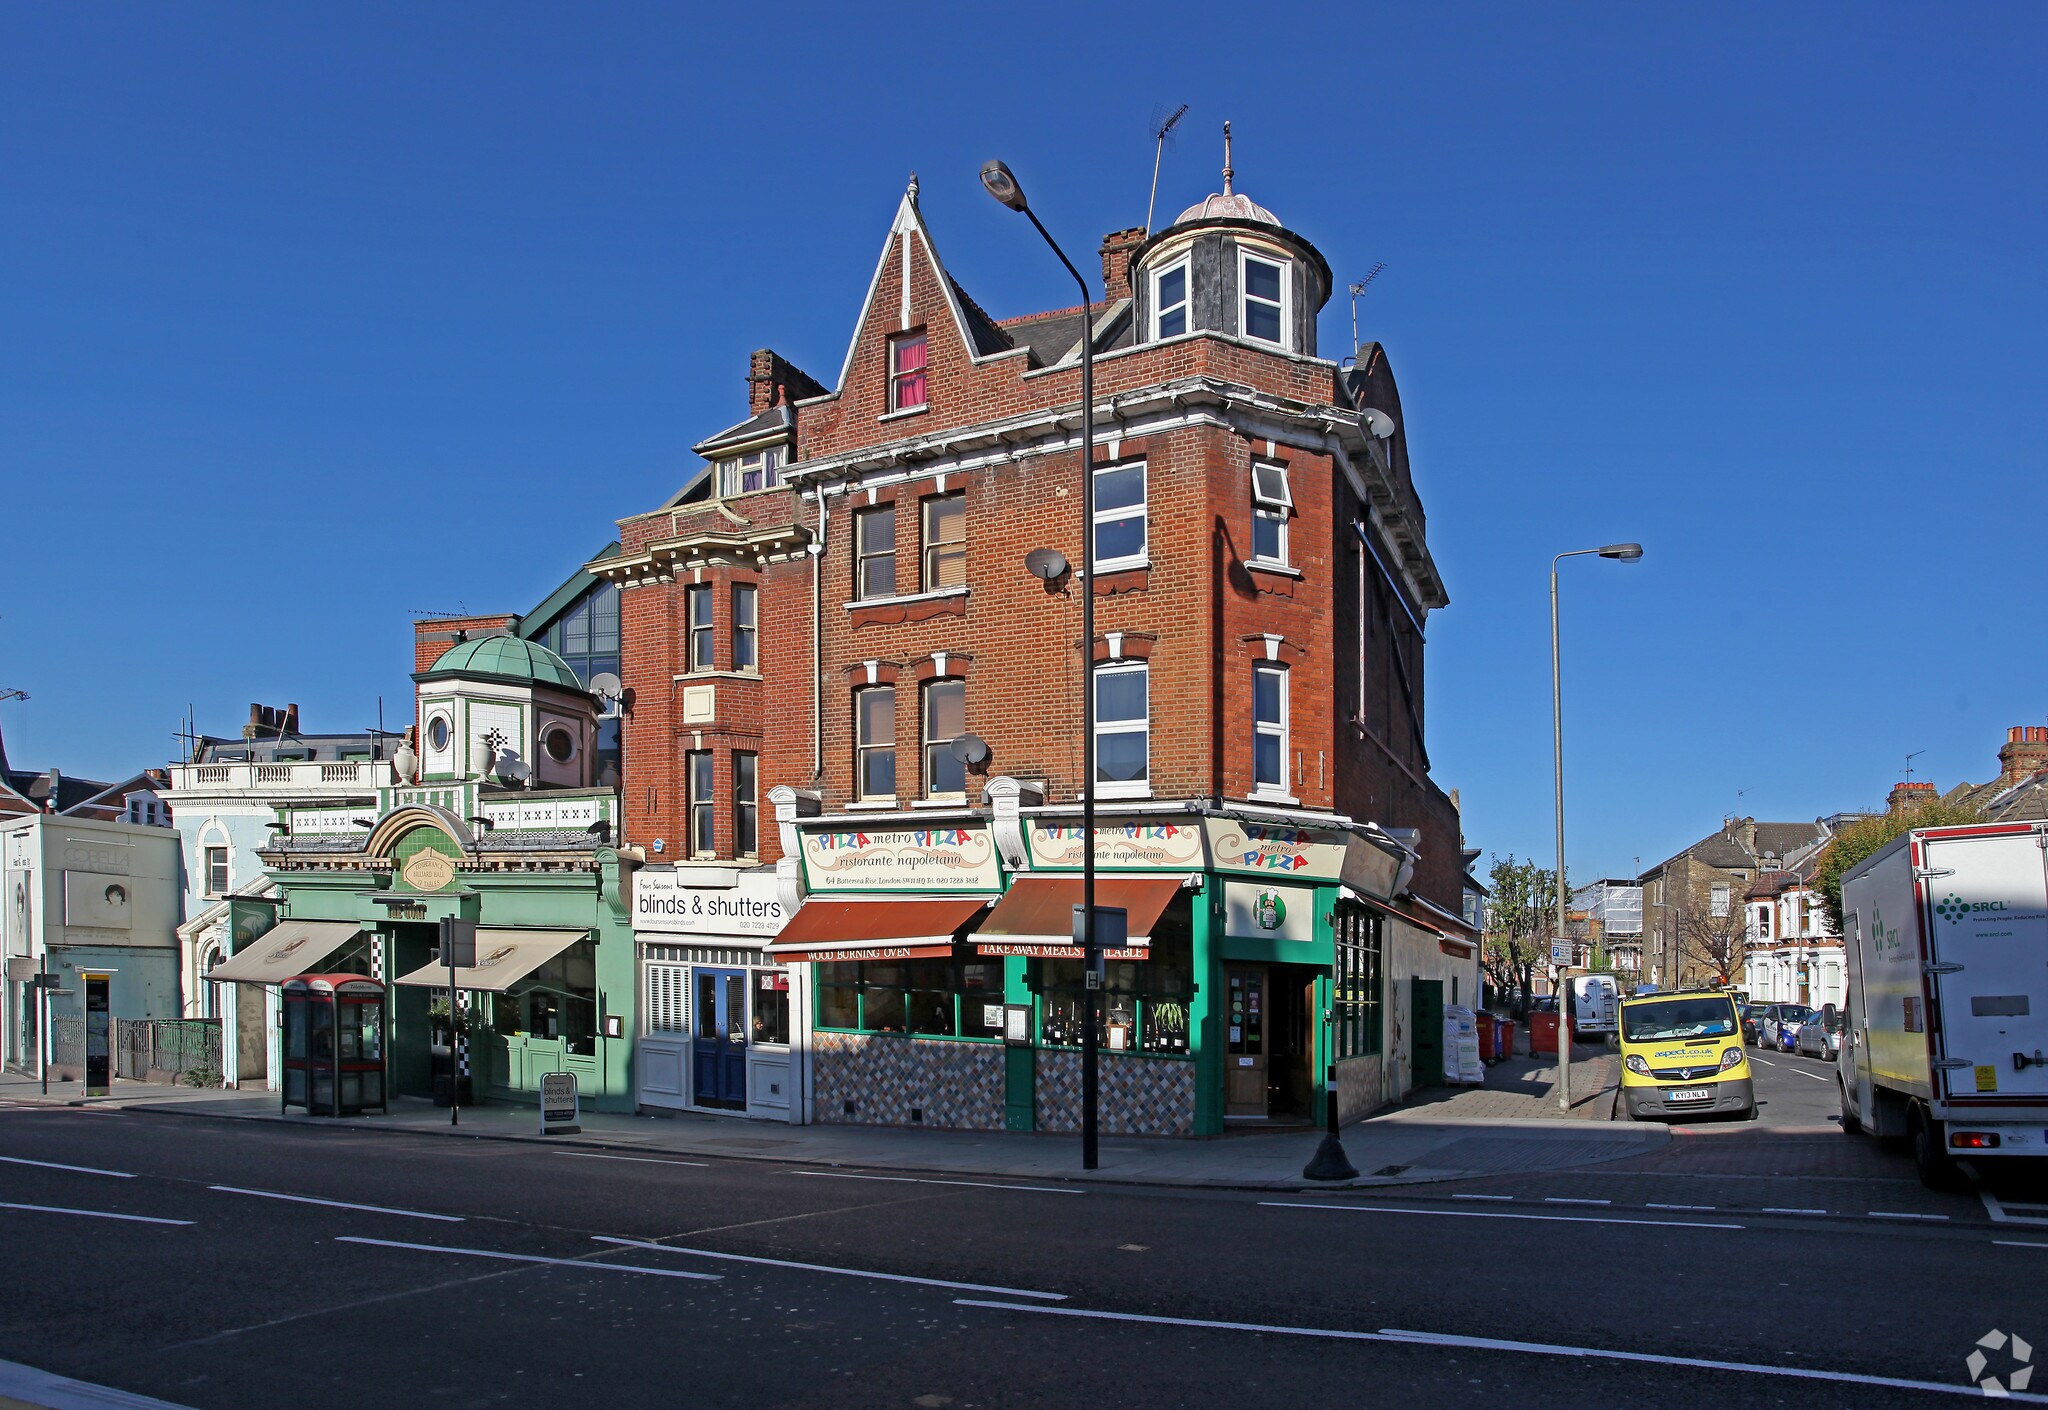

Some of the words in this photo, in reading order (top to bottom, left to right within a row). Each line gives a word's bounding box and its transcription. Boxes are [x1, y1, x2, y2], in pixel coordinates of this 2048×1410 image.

[1100, 826, 1124, 836] metro
[1124, 822, 1180, 840] PIZZA
[1246, 826, 1312, 846] PIZZA
[818, 831, 870, 850] PIZZA
[872, 832, 910, 844] metro
[914, 830, 972, 846] PIZZA
[1113, 849, 1164, 862] napoletano
[1260, 844, 1292, 852] metro
[840, 855, 892, 866] ristorante
[897, 853, 960, 870] napoletano
[1243, 850, 1309, 870] PIZZA
[640, 879, 652, 890] Four
[652, 880, 673, 890] Seasons
[640, 894, 686, 914] blinds
[692, 895, 703, 915] &
[708, 896, 781, 918] shutters
[1972, 901, 2008, 912] SRCL
[1886, 928, 1900, 950] SRCL
[807, 951, 834, 960] WOOD
[837, 949, 880, 960] BURNING
[883, 948, 910, 958] OVEN
[983, 945, 1010, 954] TAKE
[1012, 945, 1039, 955] AWAY
[1042, 946, 1080, 956] MEALS
[1088, 973, 1098, 988] H
[1654, 1048, 1713, 1058] aspect.co.uk
